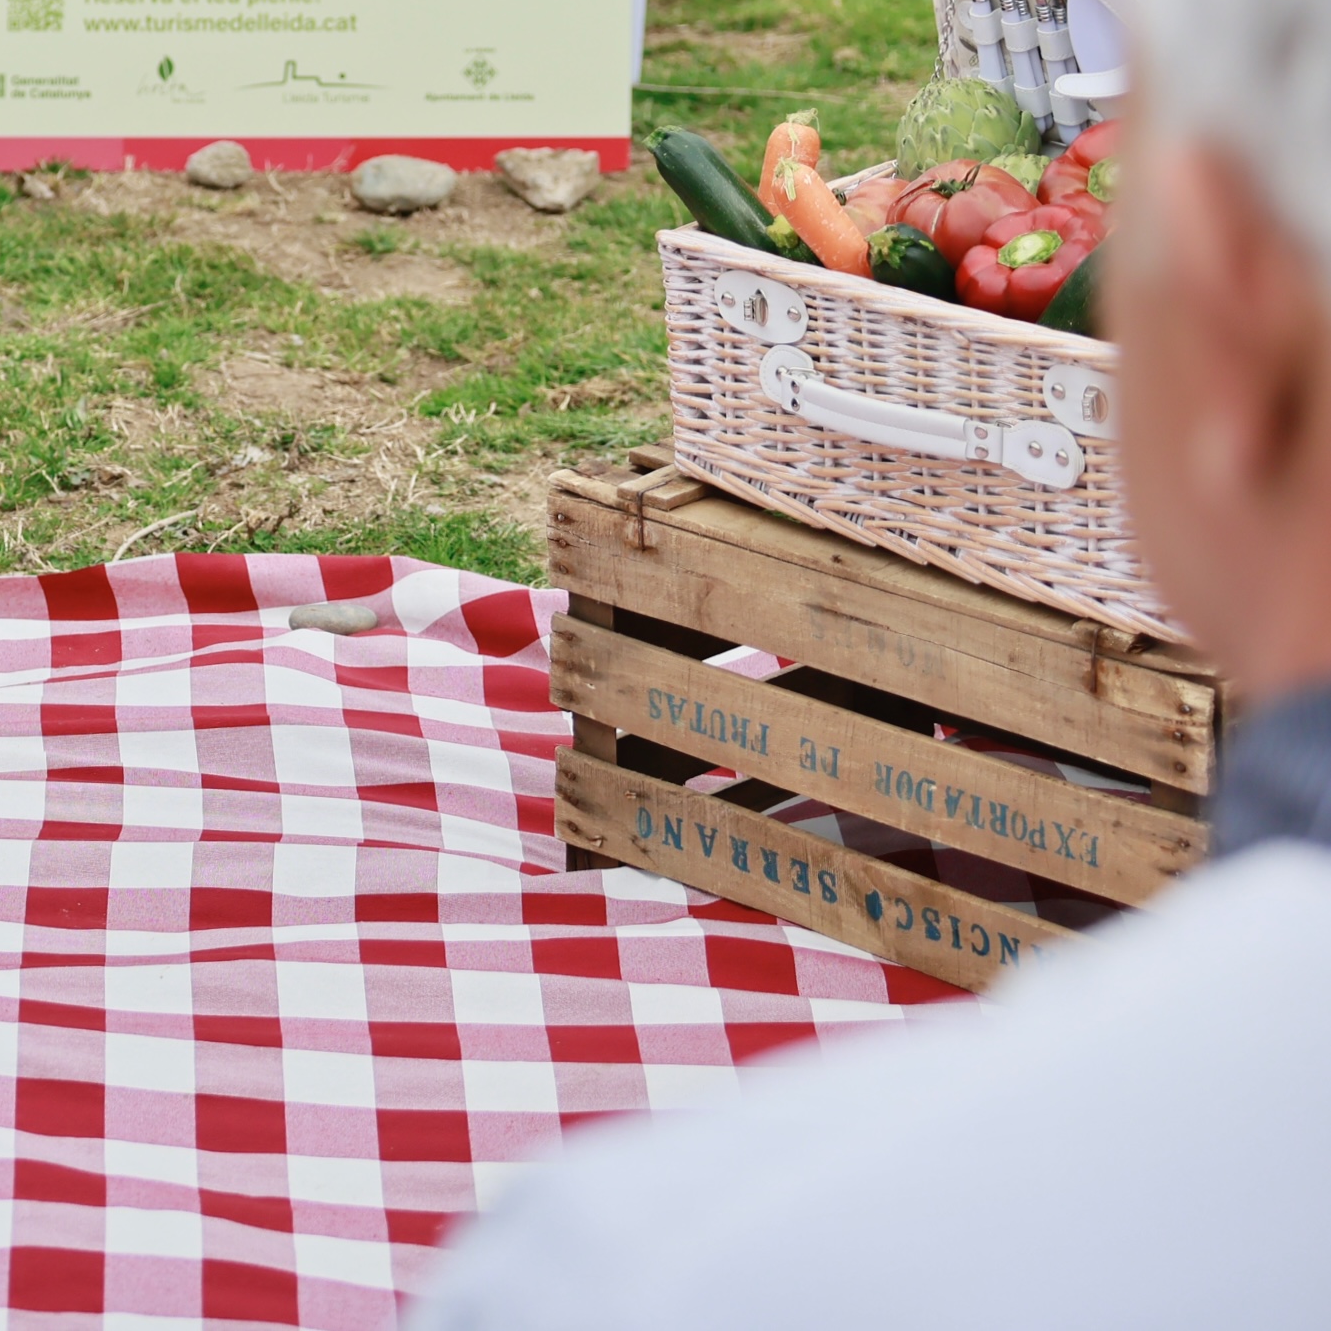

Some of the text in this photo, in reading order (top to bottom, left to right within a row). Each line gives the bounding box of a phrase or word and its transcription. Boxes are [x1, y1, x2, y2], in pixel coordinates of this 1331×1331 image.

[83, 12, 358, 34] www.turismedelleida.cat
[10, 74, 80, 87] Generalitat
[10, 87, 92, 101] de Catalunya
[647, 687, 1101, 868] EXPORTADOR DE FRUTAS
[636, 806, 838, 904] SERRANO
